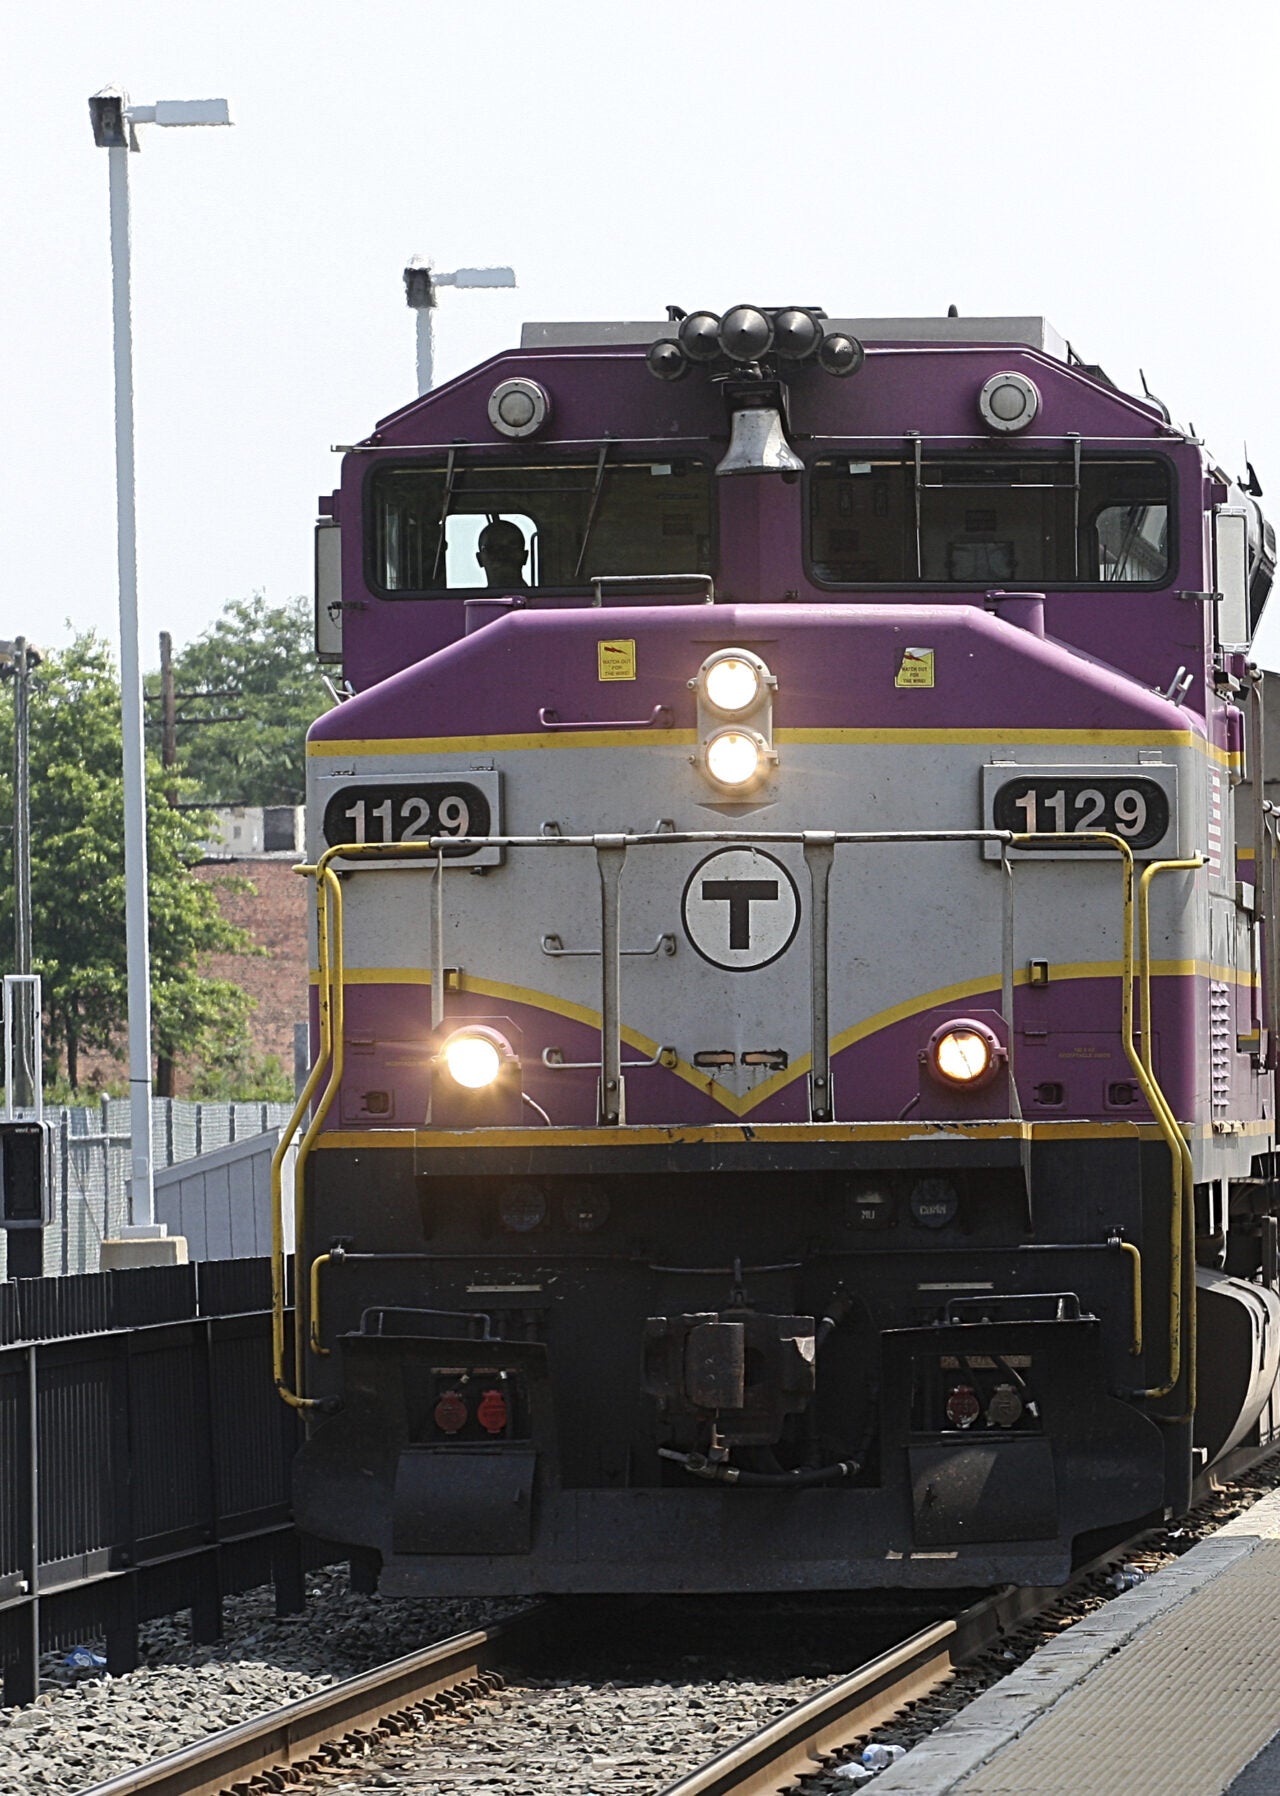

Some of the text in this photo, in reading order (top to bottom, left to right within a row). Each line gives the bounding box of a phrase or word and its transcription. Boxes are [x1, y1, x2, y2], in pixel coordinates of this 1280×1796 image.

[345, 796, 469, 844] 1129
[1015, 788, 1147, 838] 1129
[702, 880, 779, 950] T
